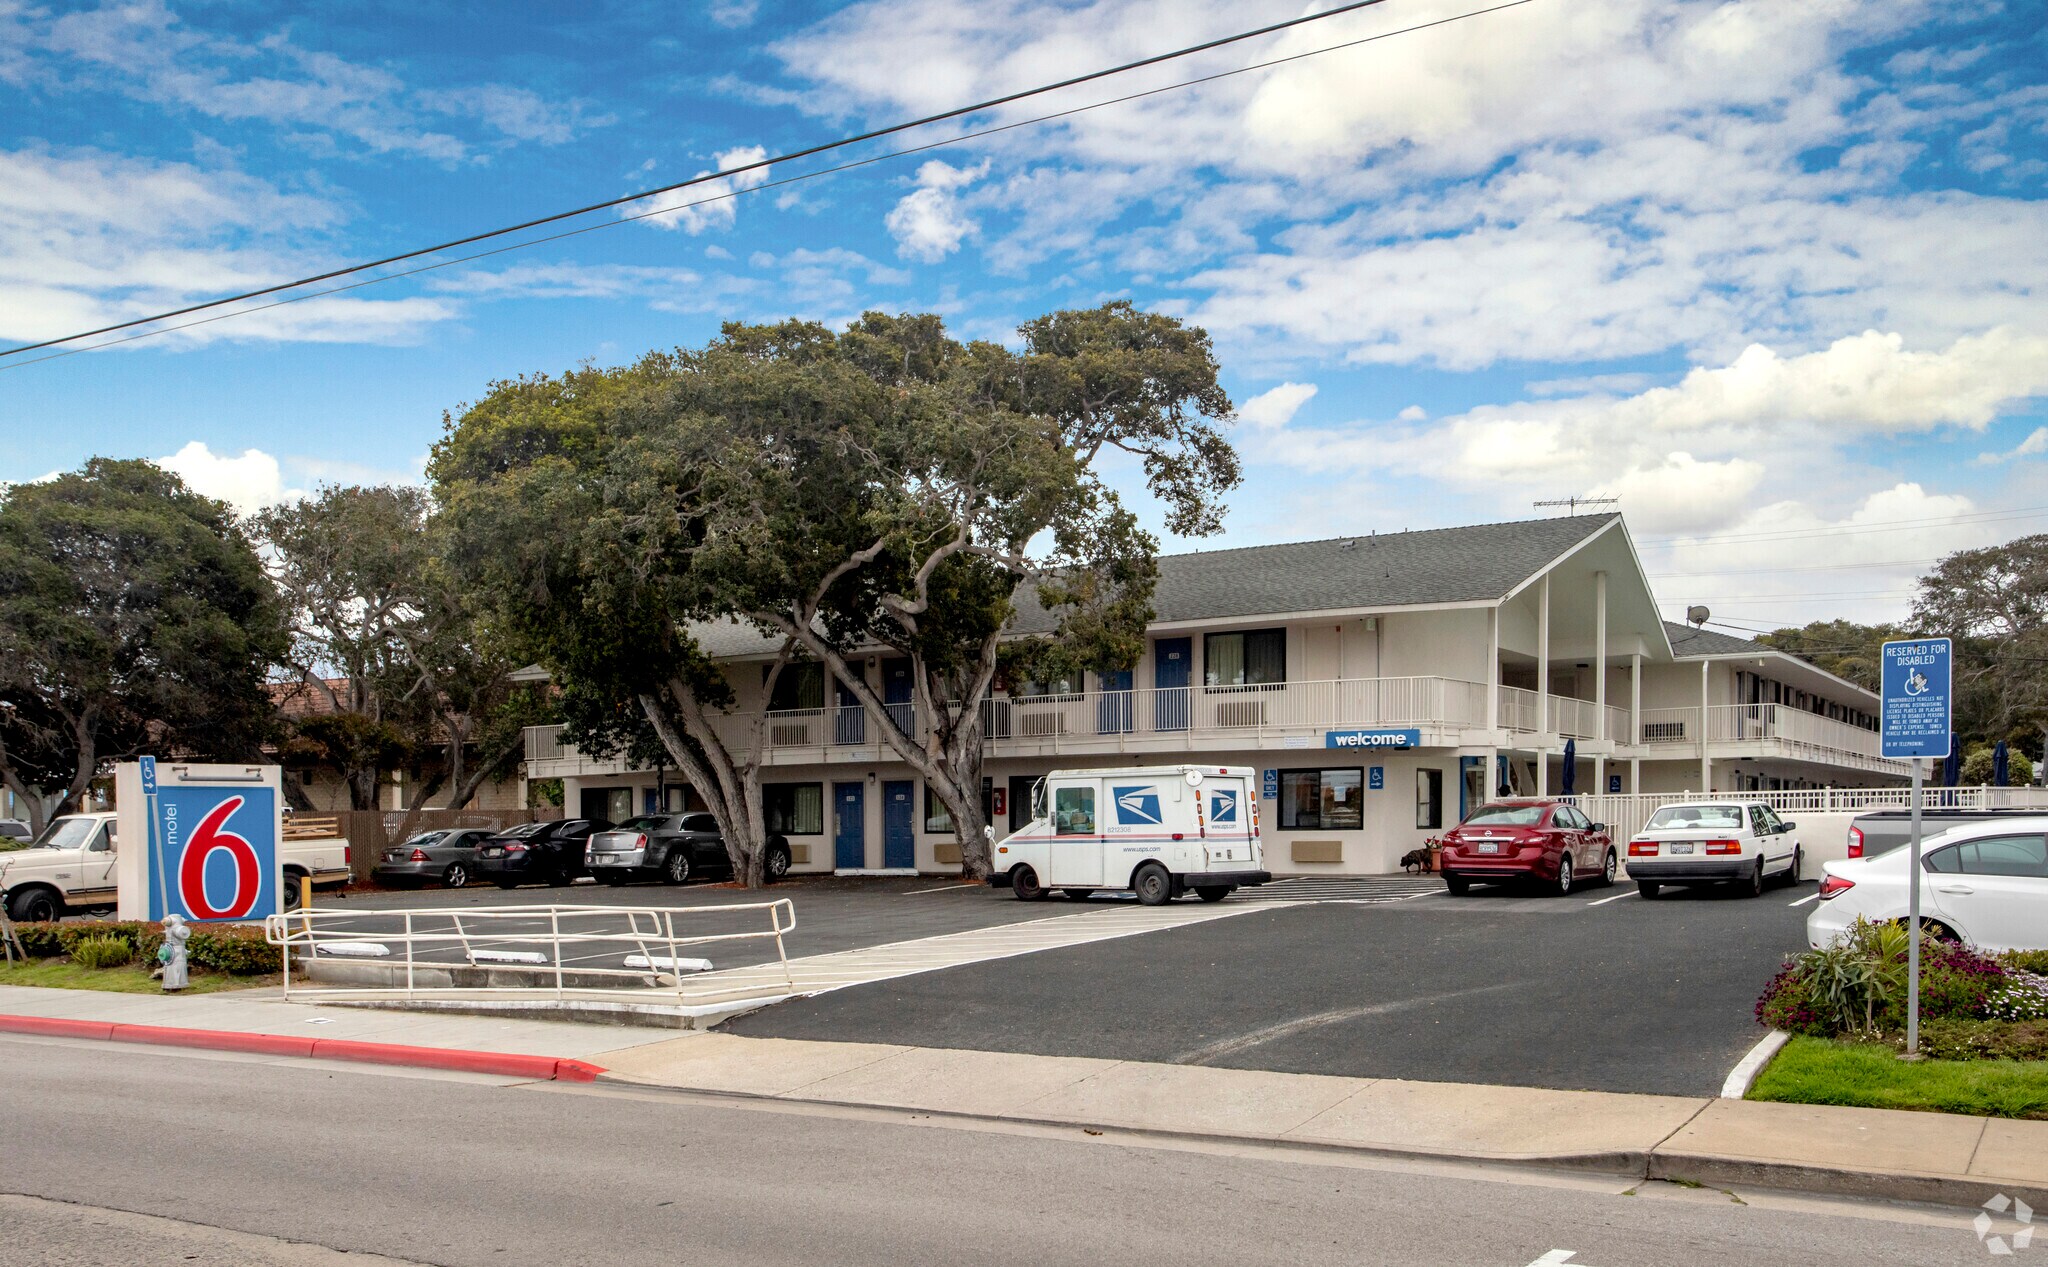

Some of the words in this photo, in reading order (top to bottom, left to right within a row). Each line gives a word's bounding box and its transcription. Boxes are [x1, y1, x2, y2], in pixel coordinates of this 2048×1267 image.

[1886, 646, 1927, 657] RESERVED
[1930, 644, 1946, 654] FOR
[1897, 655, 1935, 666] DISABLED
[1335, 732, 1407, 747] welcome
[163, 803, 178, 845] motel
[177, 794, 262, 921] 6
